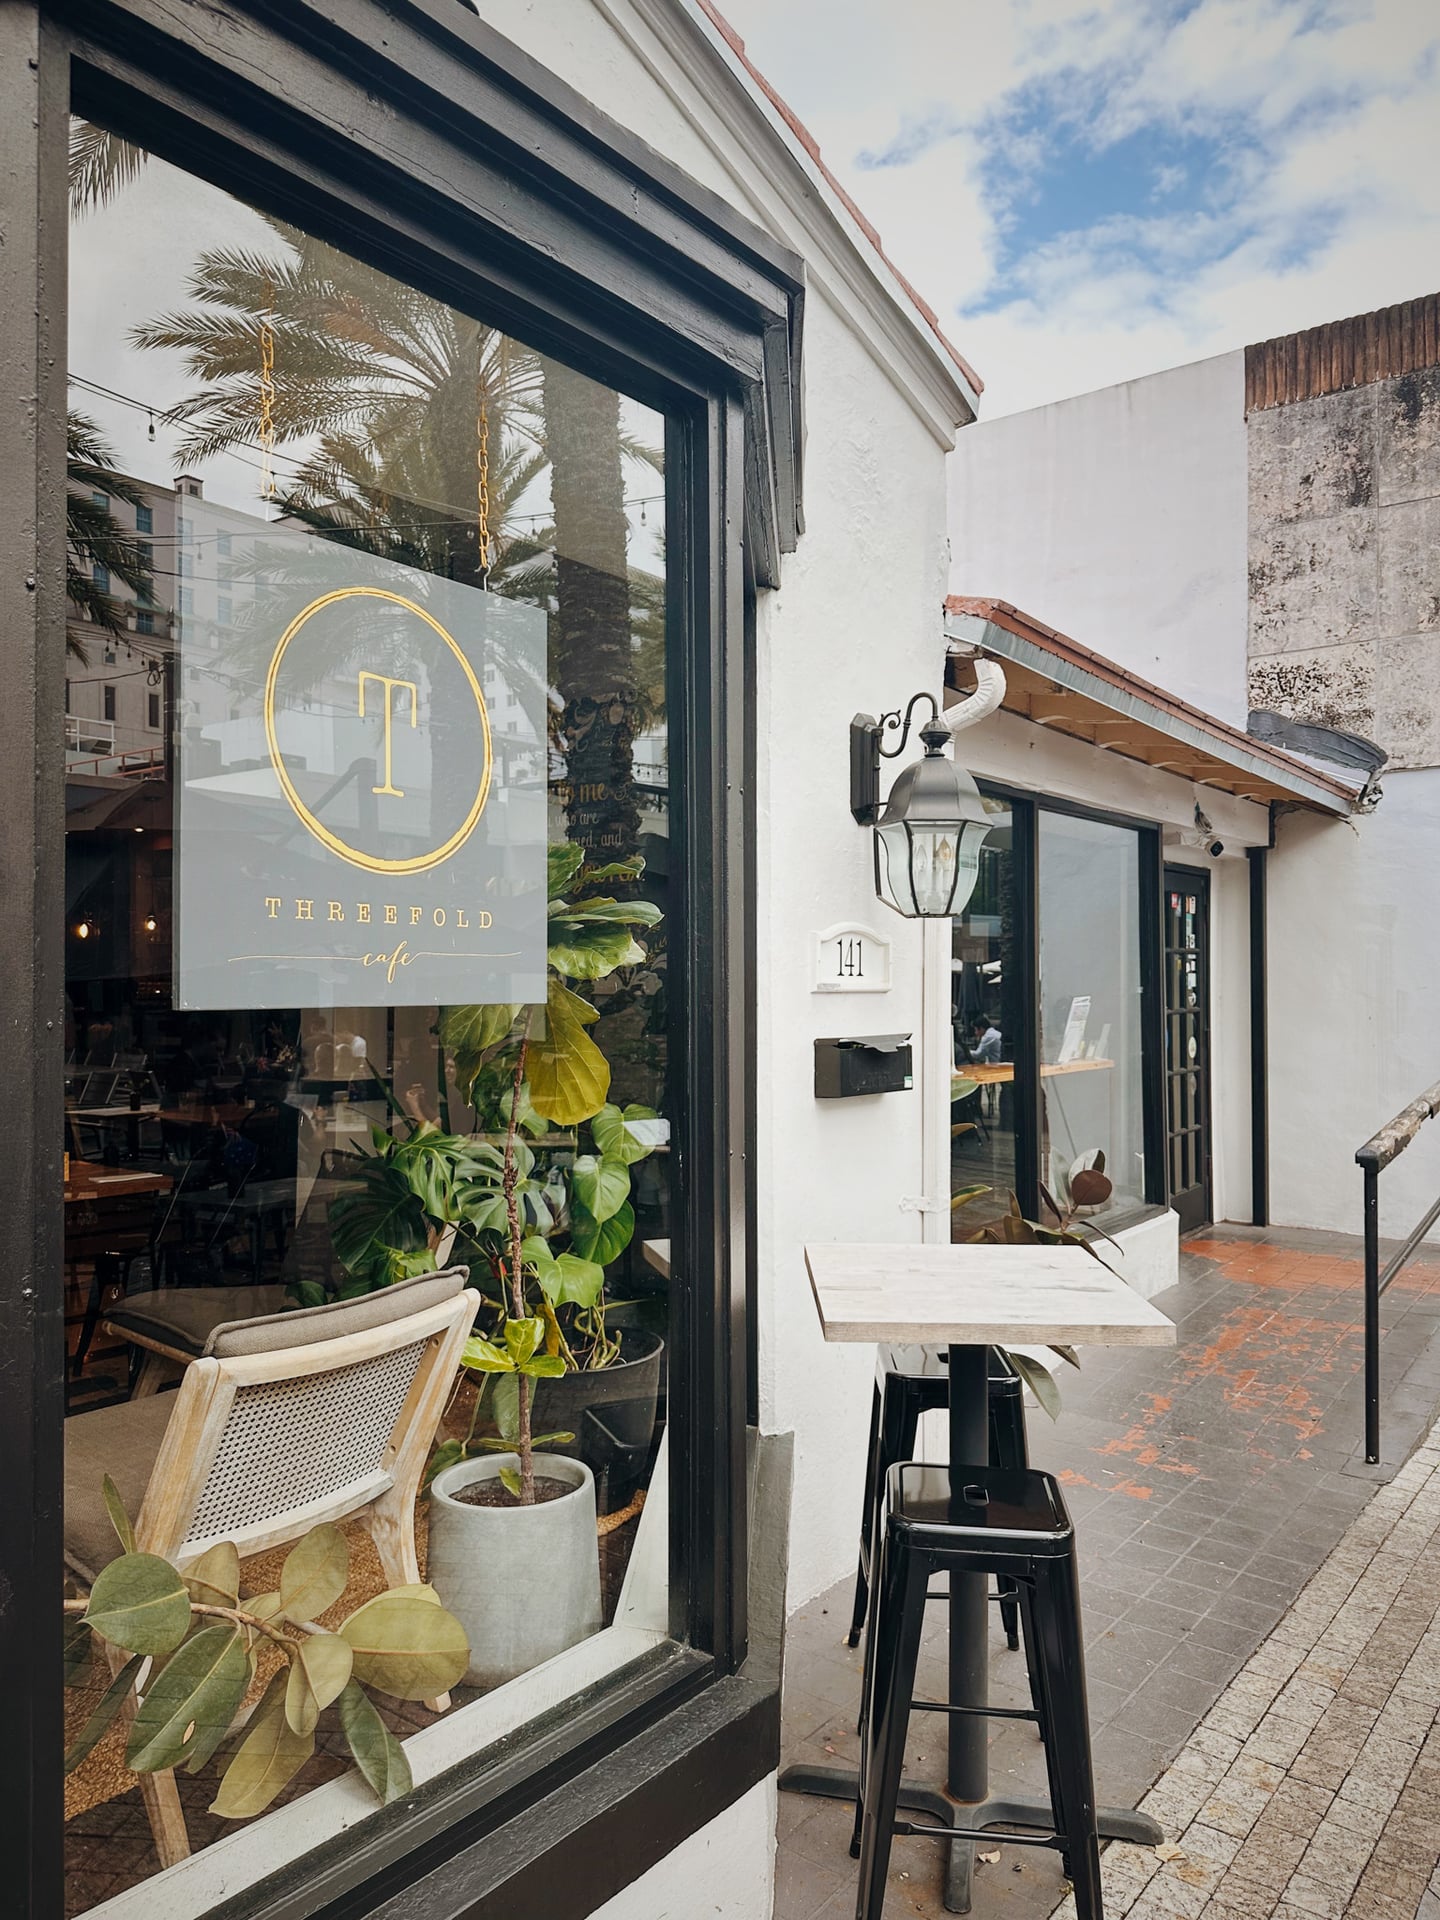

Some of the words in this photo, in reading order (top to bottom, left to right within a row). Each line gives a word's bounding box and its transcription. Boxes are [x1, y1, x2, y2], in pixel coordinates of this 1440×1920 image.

[358, 671, 417, 797] T
[580, 782, 609, 803] me
[580, 812, 600, 825] are
[601, 827, 625, 848] and
[265, 897, 493, 930] THREEFOLD
[362, 940, 416, 984] cafe
[836, 938, 864, 977] 141
